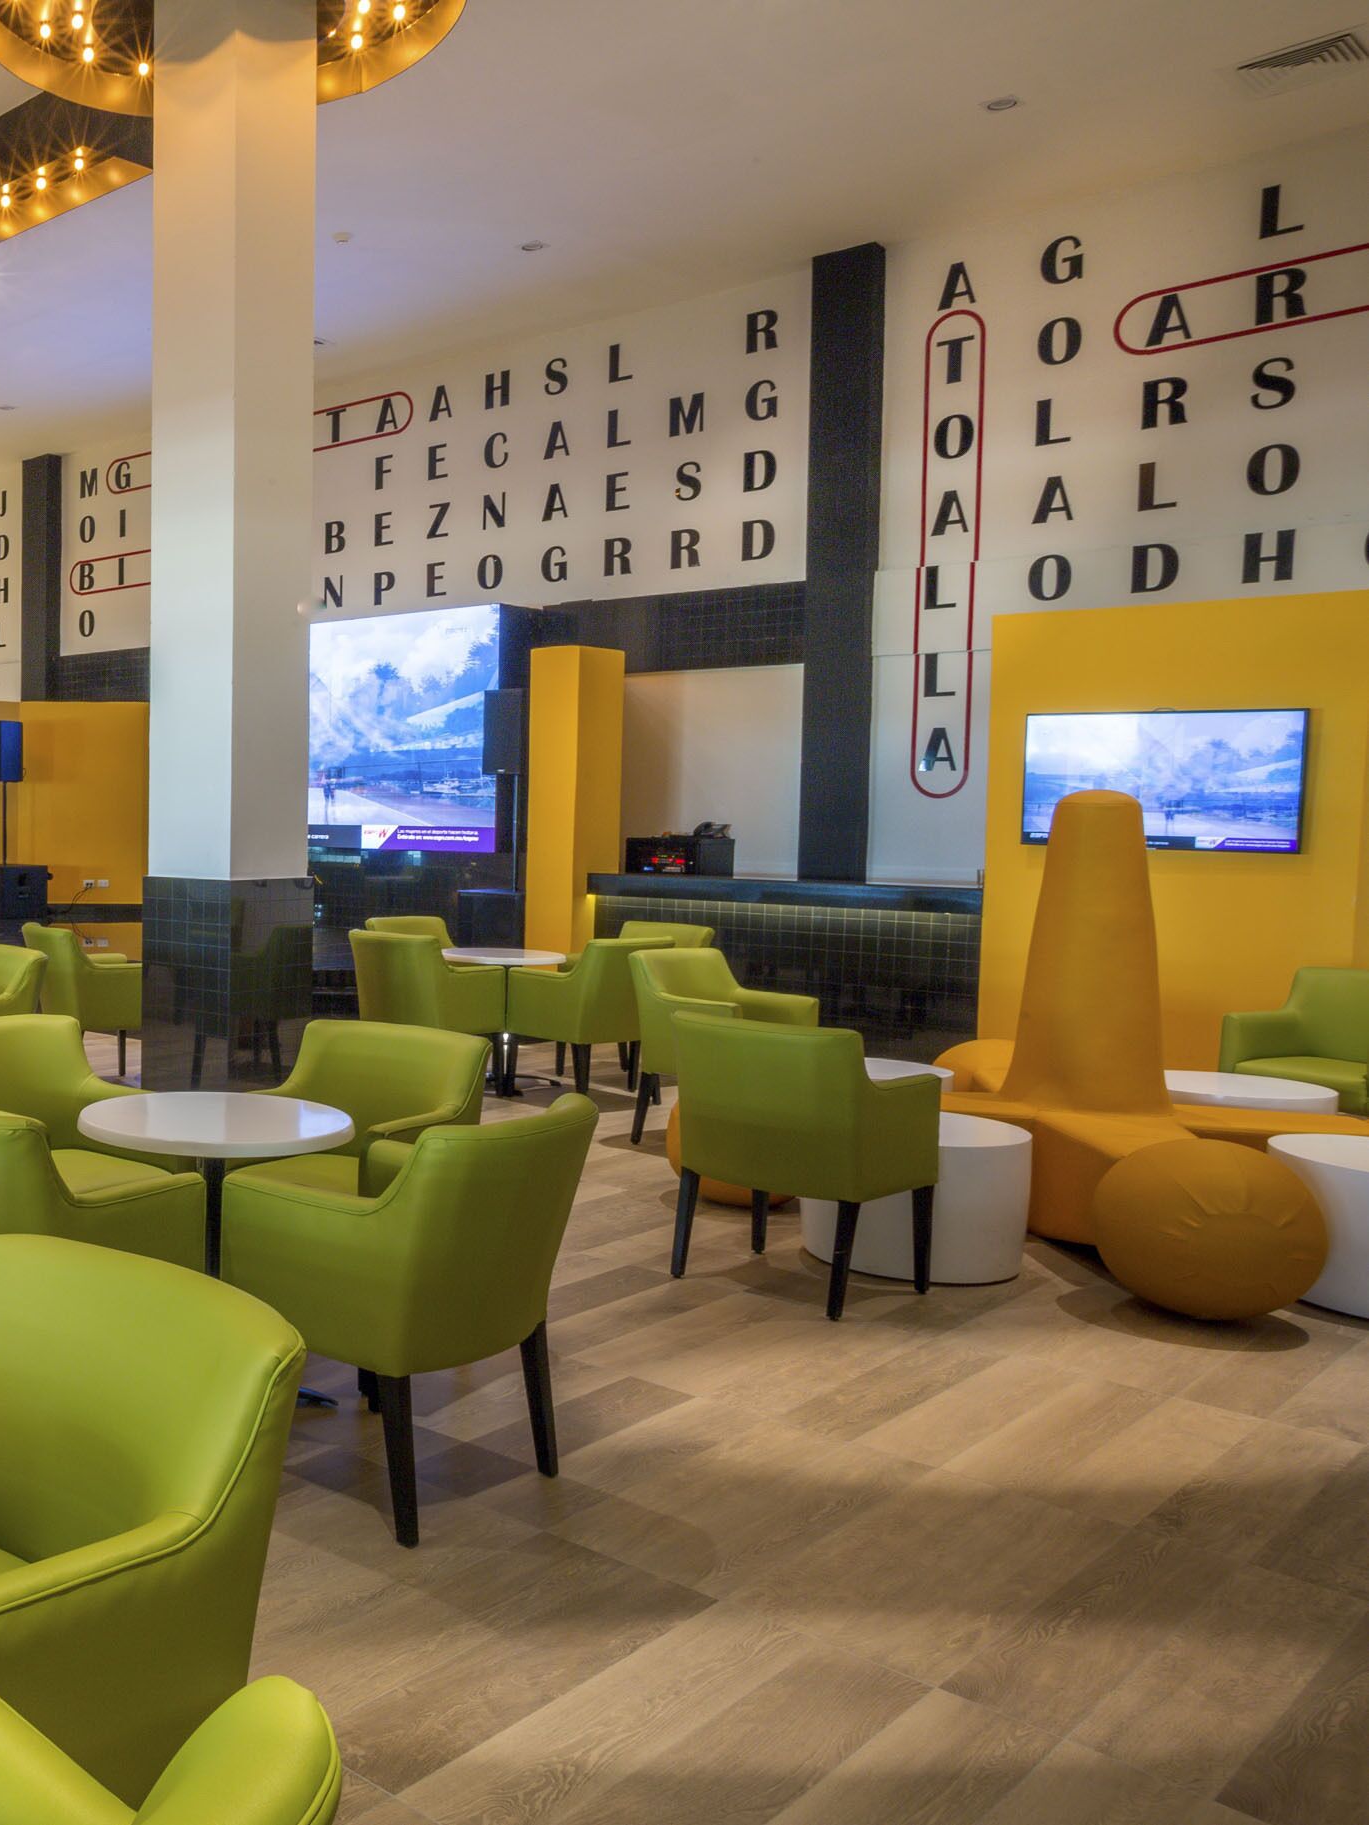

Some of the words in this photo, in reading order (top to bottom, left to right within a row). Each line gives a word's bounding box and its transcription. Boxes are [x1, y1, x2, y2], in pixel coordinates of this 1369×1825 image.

[937, 262, 976, 311] A
[1040, 236, 1084, 285] G
[1258, 184, 1305, 240] L
[1037, 316, 1082, 366] O
[1145, 293, 1192, 347] A
[1255, 267, 1308, 326] R
[325, 408, 347, 443] T
[376, 397, 398, 433] A
[429, 385, 453, 422] A
[484, 369, 510, 410] H
[545, 357, 569, 396] S
[608, 344, 634, 384] L
[745, 309, 779, 355] R
[1035, 399, 1071, 447] L
[1141, 376, 1188, 430] R
[1250, 356, 1296, 410] S
[375, 454, 394, 491] F
[427, 444, 448, 481] E
[484, 432, 509, 469] C
[544, 421, 570, 461] A
[606, 409, 632, 449] L
[668, 392, 705, 437] M
[745, 379, 779, 421] G
[79, 468, 98, 499] M
[115, 461, 131, 489] G
[324, 520, 346, 555] B
[374, 512, 394, 547] E
[427, 502, 450, 540] Z
[482, 492, 506, 531] N
[542, 484, 568, 522] A
[605, 472, 630, 513] E
[675, 461, 702, 501] S
[742, 450, 777, 492] D
[1032, 476, 1073, 525] A
[1137, 462, 1178, 512] L
[1246, 443, 1300, 496] O
[79, 516, 96, 543] O
[374, 571, 395, 606] P
[426, 562, 447, 598] E
[477, 554, 504, 590] O
[541, 545, 568, 583] G
[604, 537, 632, 577] R
[670, 529, 701, 570] R
[741, 519, 775, 562] D
[1028, 554, 1072, 601] O
[1131, 543, 1180, 594] D
[1242, 528, 1296, 584] H
[79, 563, 95, 591] B
[79, 609, 95, 637] O
